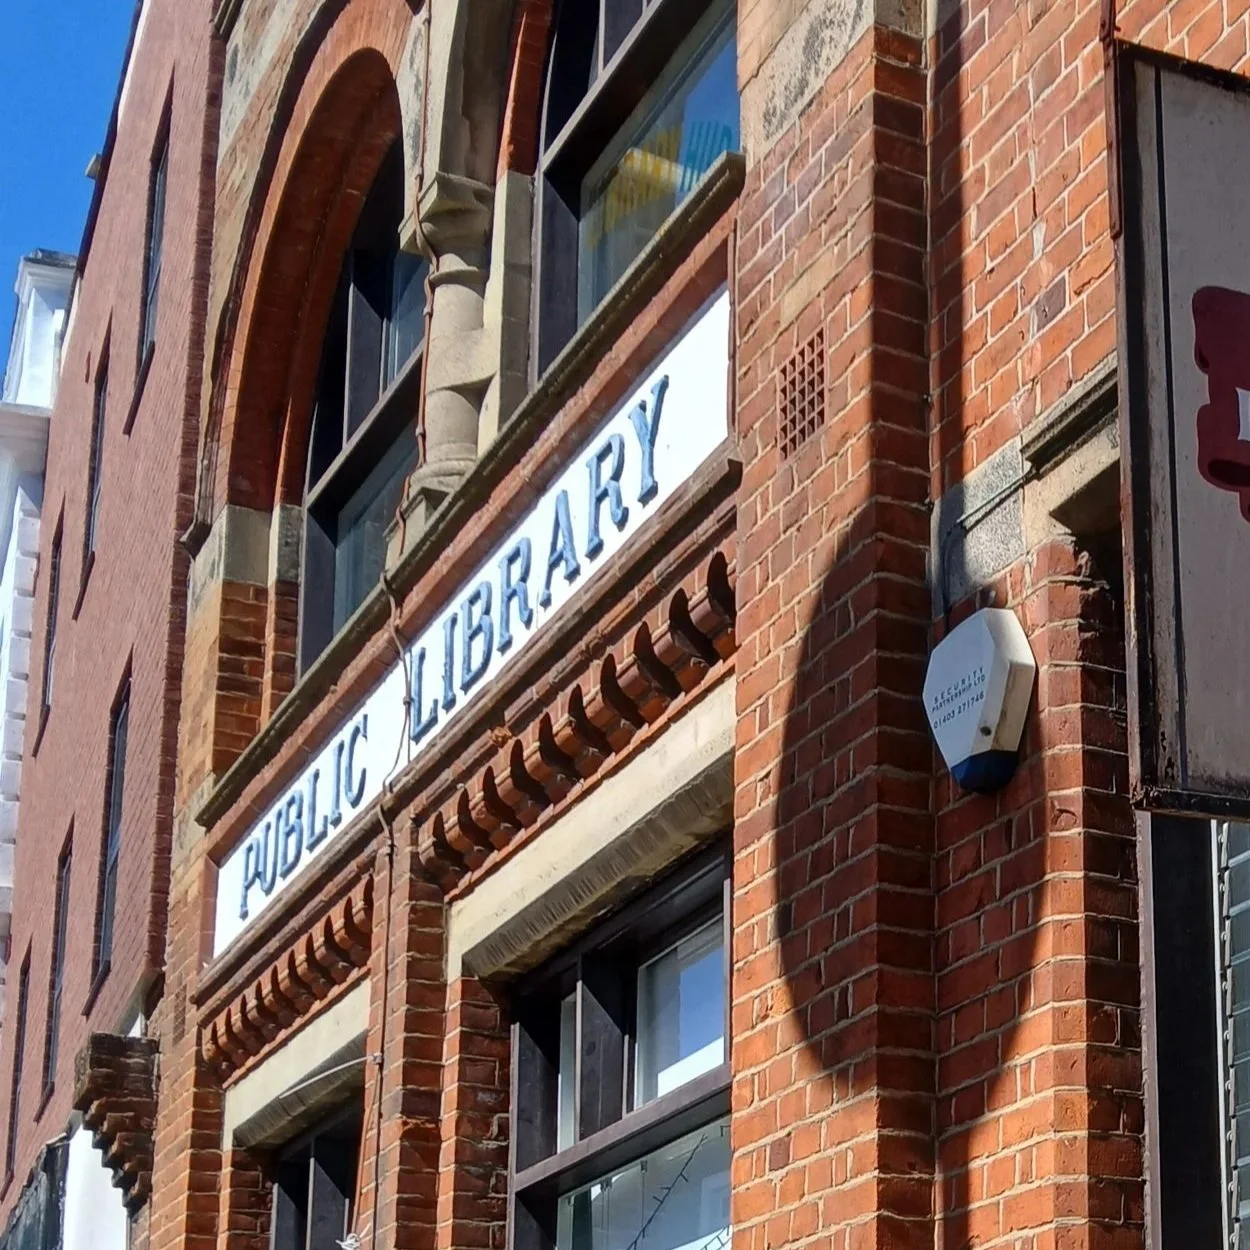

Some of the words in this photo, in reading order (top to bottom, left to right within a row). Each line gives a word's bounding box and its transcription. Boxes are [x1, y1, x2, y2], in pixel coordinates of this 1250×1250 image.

[239, 714, 369, 919] PUBLIC
[408, 374, 670, 743] LIBRARY
[932, 682, 973, 713] PARTNERSHIP
[973, 674, 986, 688] LTD
[934, 667, 985, 704] SECURITY
[933, 710, 956, 729] 01403
